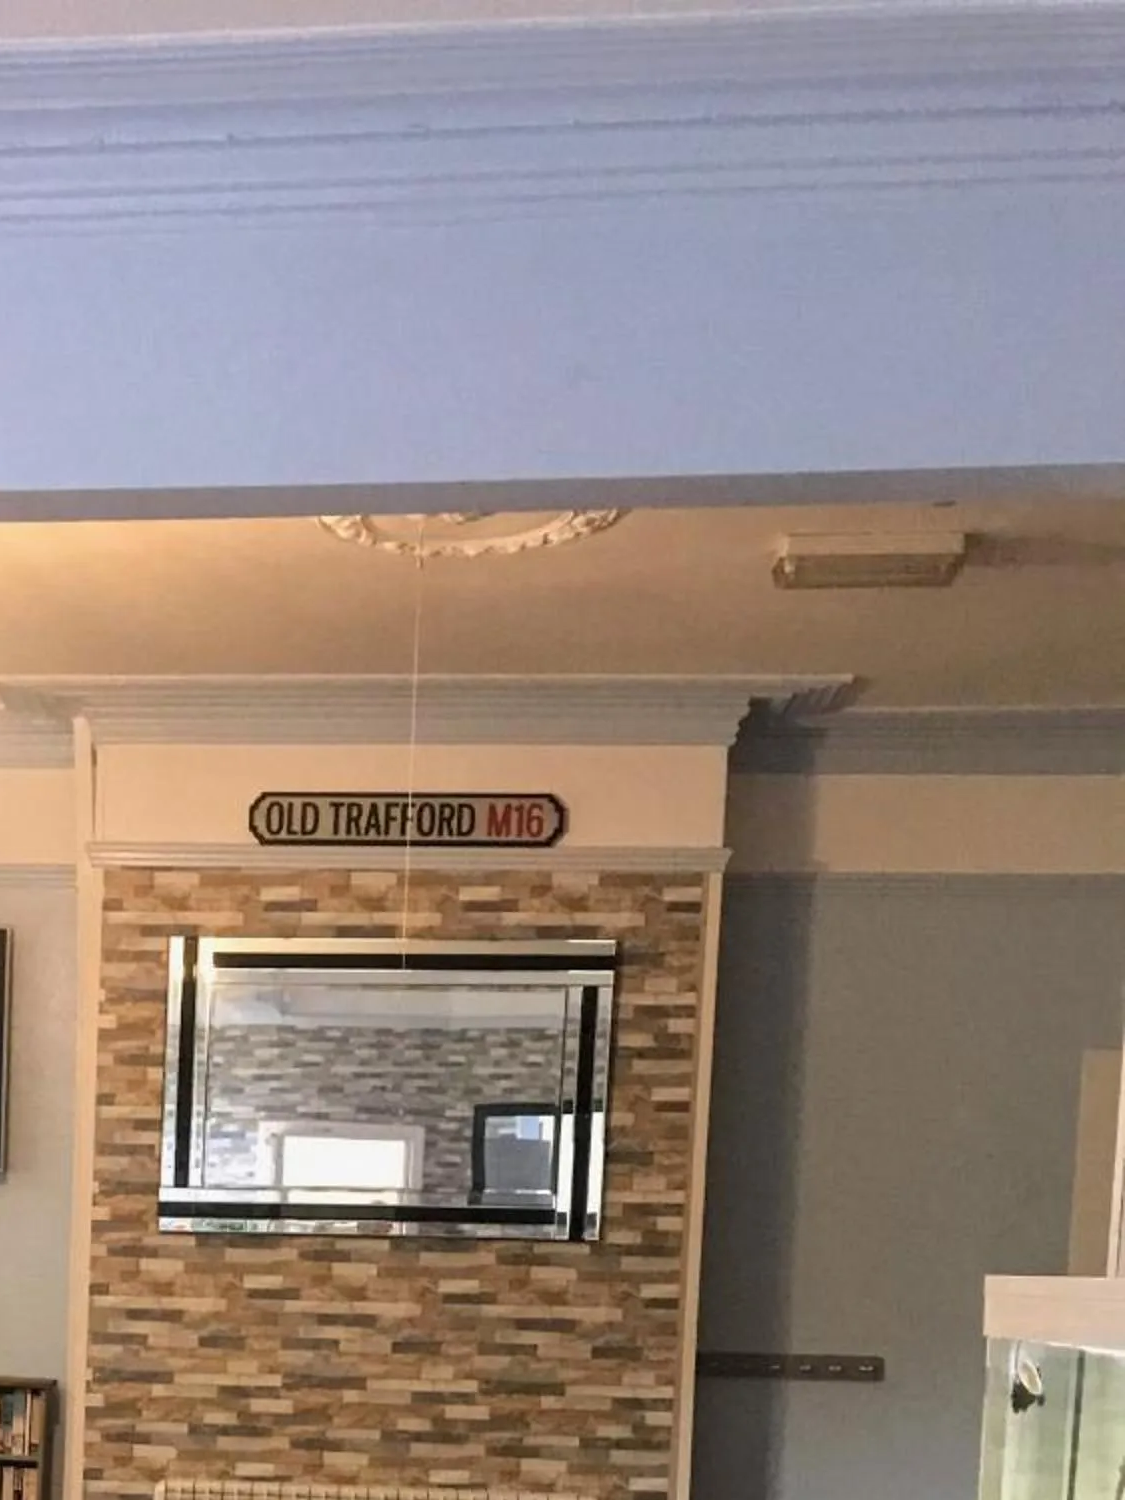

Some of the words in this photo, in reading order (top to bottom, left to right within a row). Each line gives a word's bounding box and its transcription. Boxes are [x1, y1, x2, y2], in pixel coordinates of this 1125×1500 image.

[265, 800, 320, 836] OLD
[329, 801, 475, 837] TRAFFORD
[486, 803, 545, 838] M16
